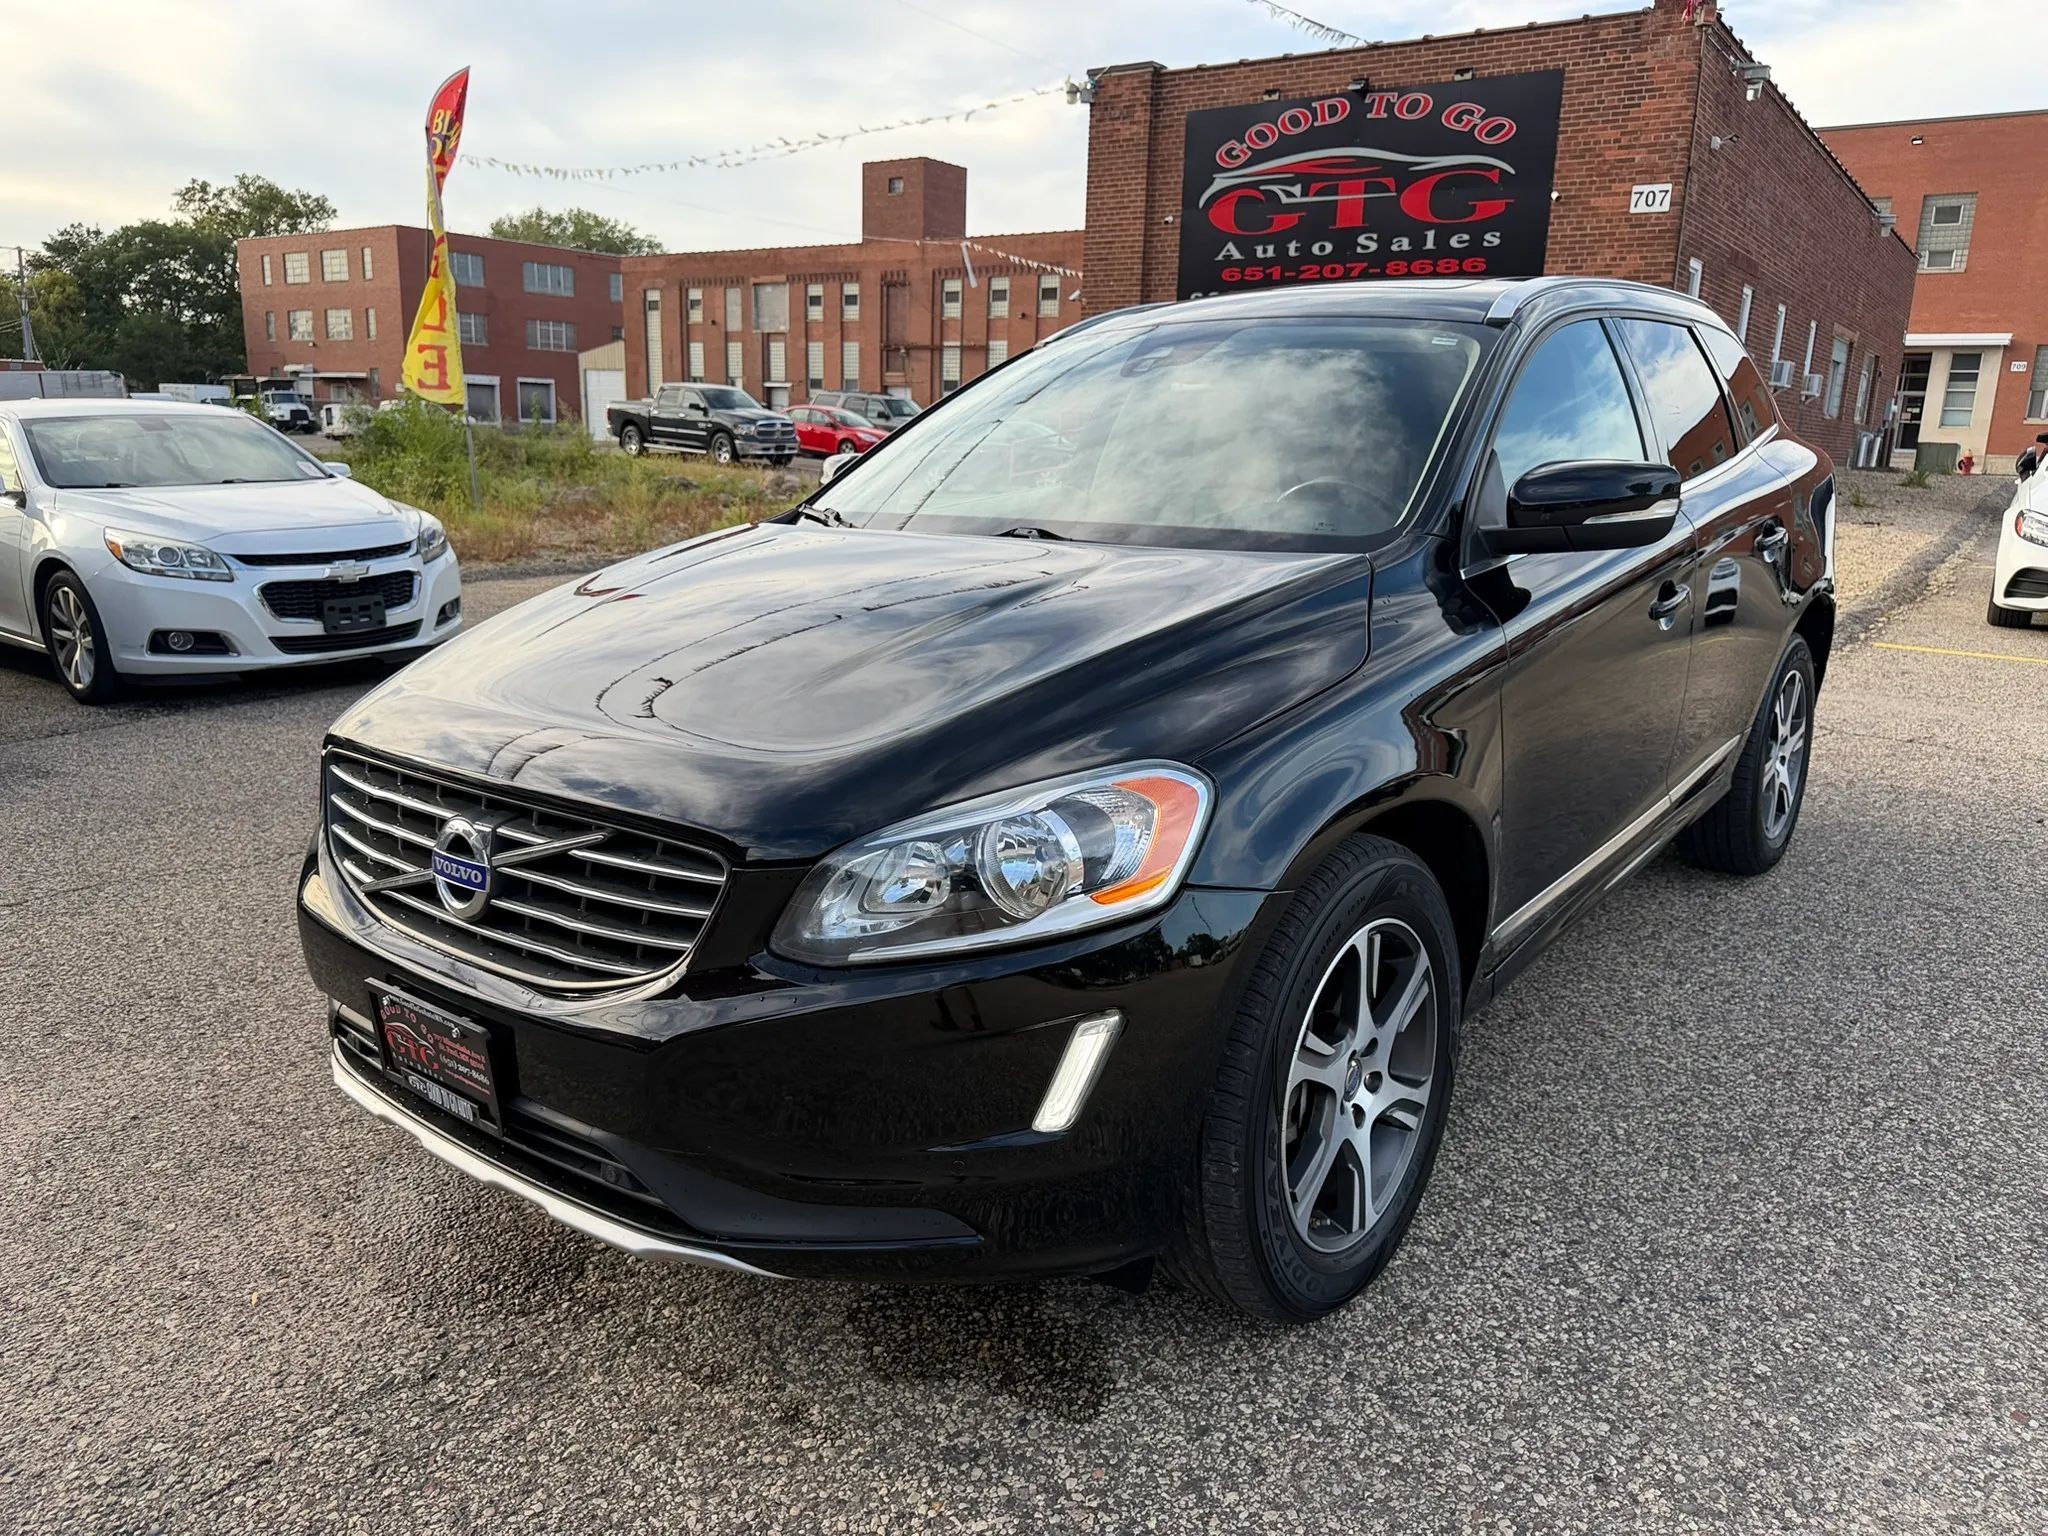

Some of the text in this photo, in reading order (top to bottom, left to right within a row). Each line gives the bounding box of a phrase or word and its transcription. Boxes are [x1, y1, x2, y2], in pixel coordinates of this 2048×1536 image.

[1215, 92, 1517, 168] GOOD TO GO
[1208, 170, 1516, 235] GTG
[1633, 190, 1670, 208] 707
[1214, 229, 1502, 262] Auto Sales
[1220, 257, 1488, 282] 651-207-8686
[434, 856, 483, 883] VOLVO
[380, 1004, 401, 1020] GOOD
